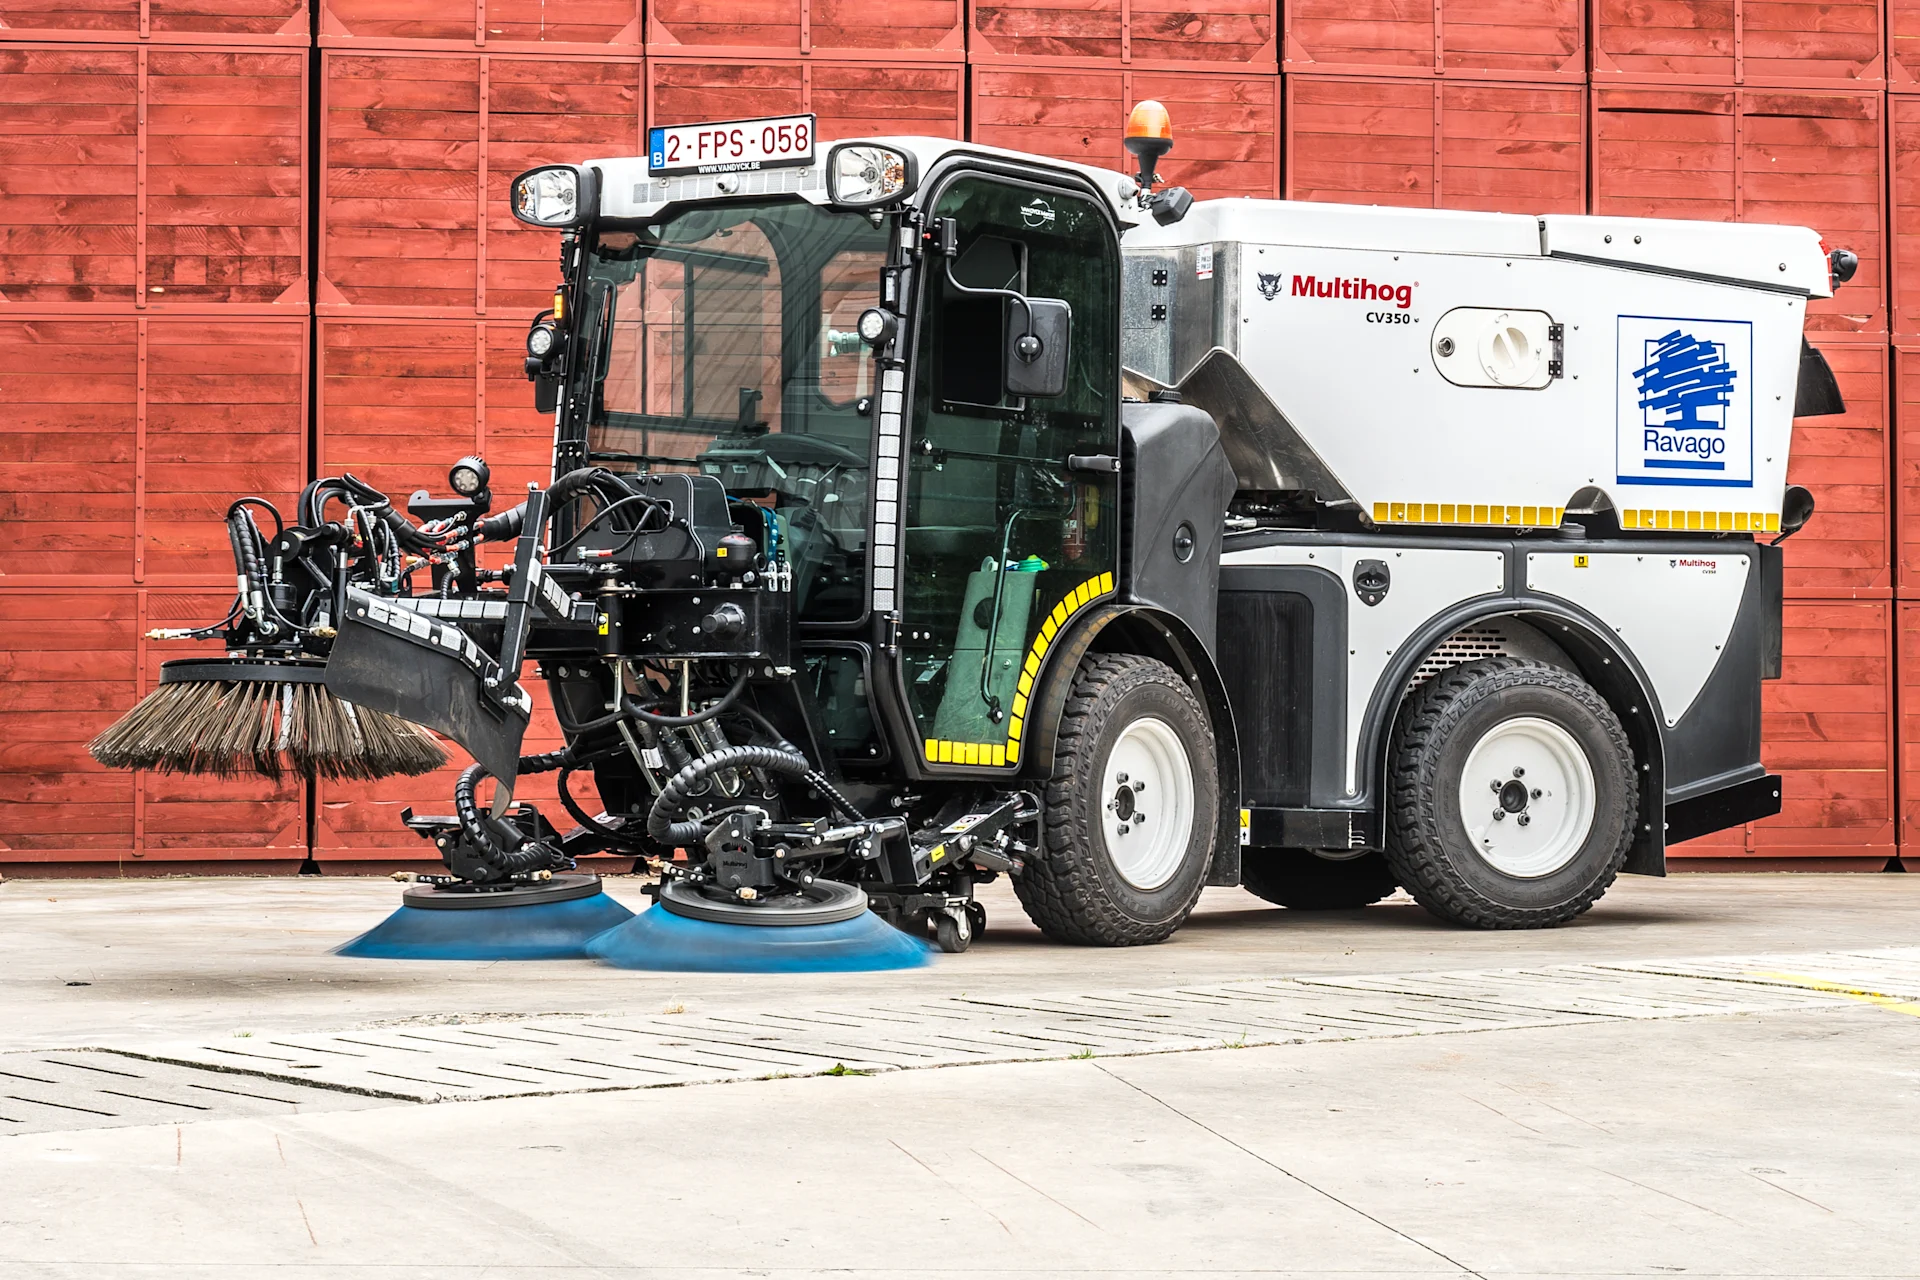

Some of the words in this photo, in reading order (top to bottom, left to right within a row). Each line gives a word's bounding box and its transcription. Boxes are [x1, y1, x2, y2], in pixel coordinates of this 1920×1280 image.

[653, 152, 663, 166] B
[667, 123, 808, 162] 2-FPS-058
[698, 161, 761, 174] WWW.VANDYCK.BE
[1366, 312, 1410, 325] CV350
[1644, 429, 1726, 459] Ravago
[1679, 559, 1716, 569] Multihog
